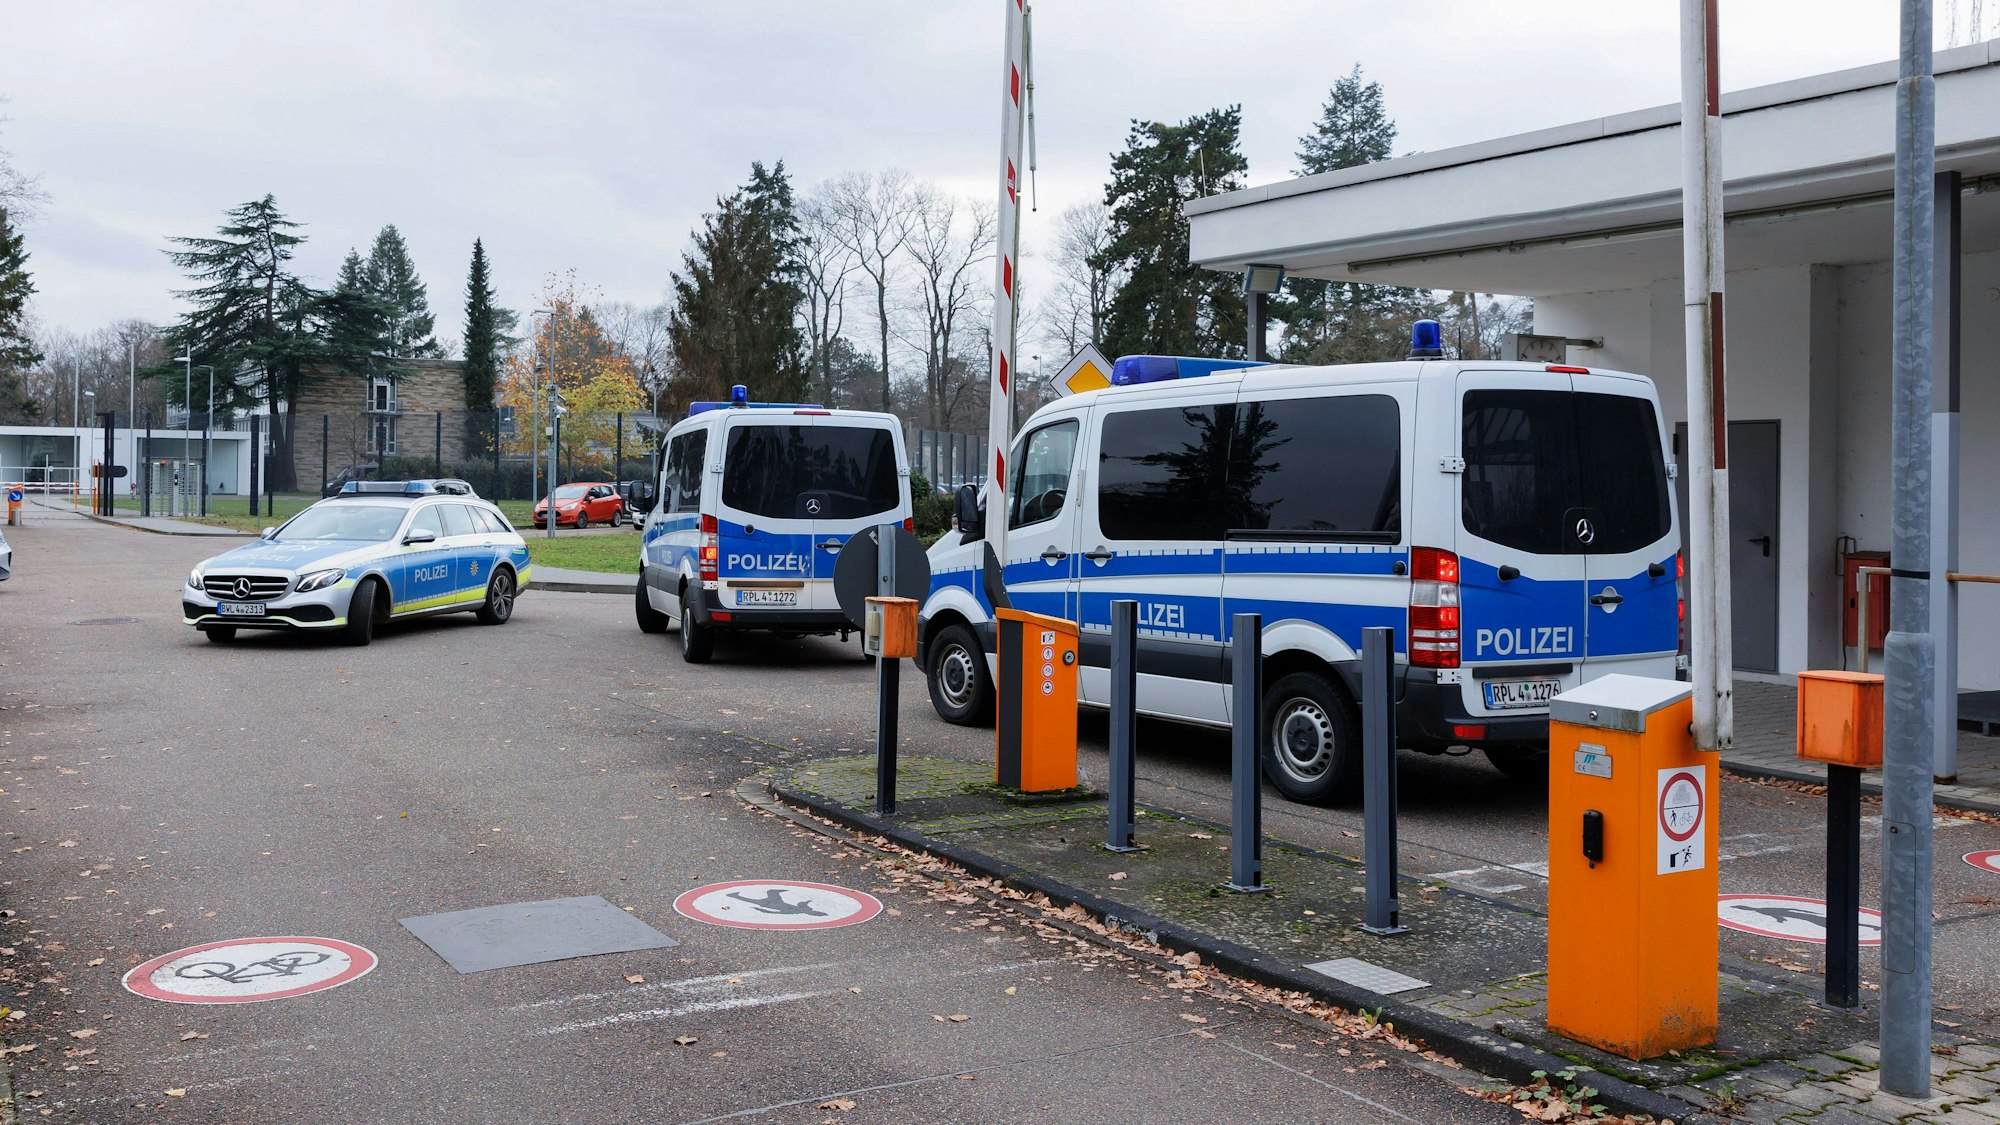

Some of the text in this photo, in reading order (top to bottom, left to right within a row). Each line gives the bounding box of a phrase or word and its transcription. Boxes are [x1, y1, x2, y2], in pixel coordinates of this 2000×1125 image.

[728, 553, 804, 571] POLIZEI
[414, 564, 448, 583] POLIZEI
[743, 592, 795, 602] RPL 4 1272
[245, 605, 264, 614] 2313
[1110, 600, 1185, 629] LIZEI
[1476, 626, 1573, 656] POLIZEI
[1493, 683, 1560, 703] RPL 4 1276
